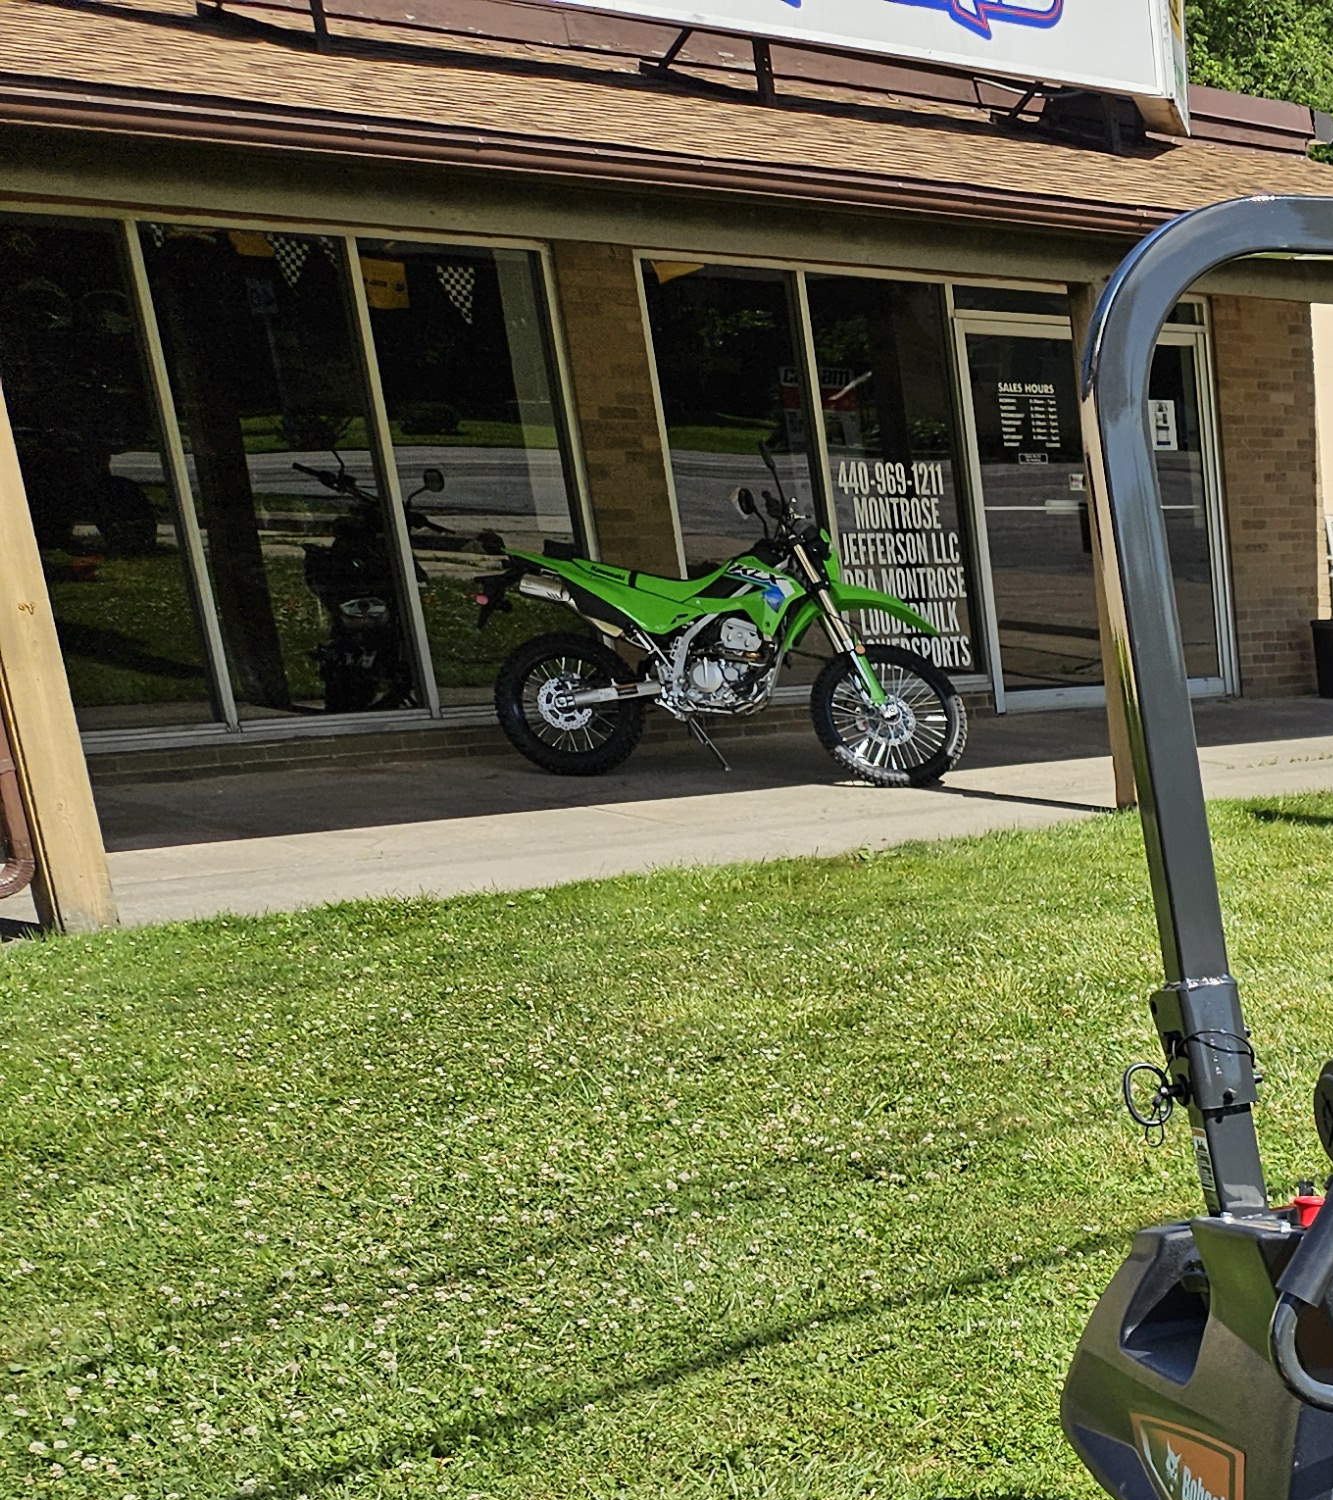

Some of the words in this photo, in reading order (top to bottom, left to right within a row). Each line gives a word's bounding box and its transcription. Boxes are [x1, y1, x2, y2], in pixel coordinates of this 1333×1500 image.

[998, 382, 1023, 393] SALES
[1024, 383, 1055, 394] HOURS
[838, 461, 945, 496] 440-969-1211
[853, 497, 942, 530] MONTROSE
[843, 532, 929, 566] JEFFERSON
[931, 532, 961, 565] LLC
[590, 565, 626, 581] Kawasaki
[881, 567, 967, 600] MONTROSE
